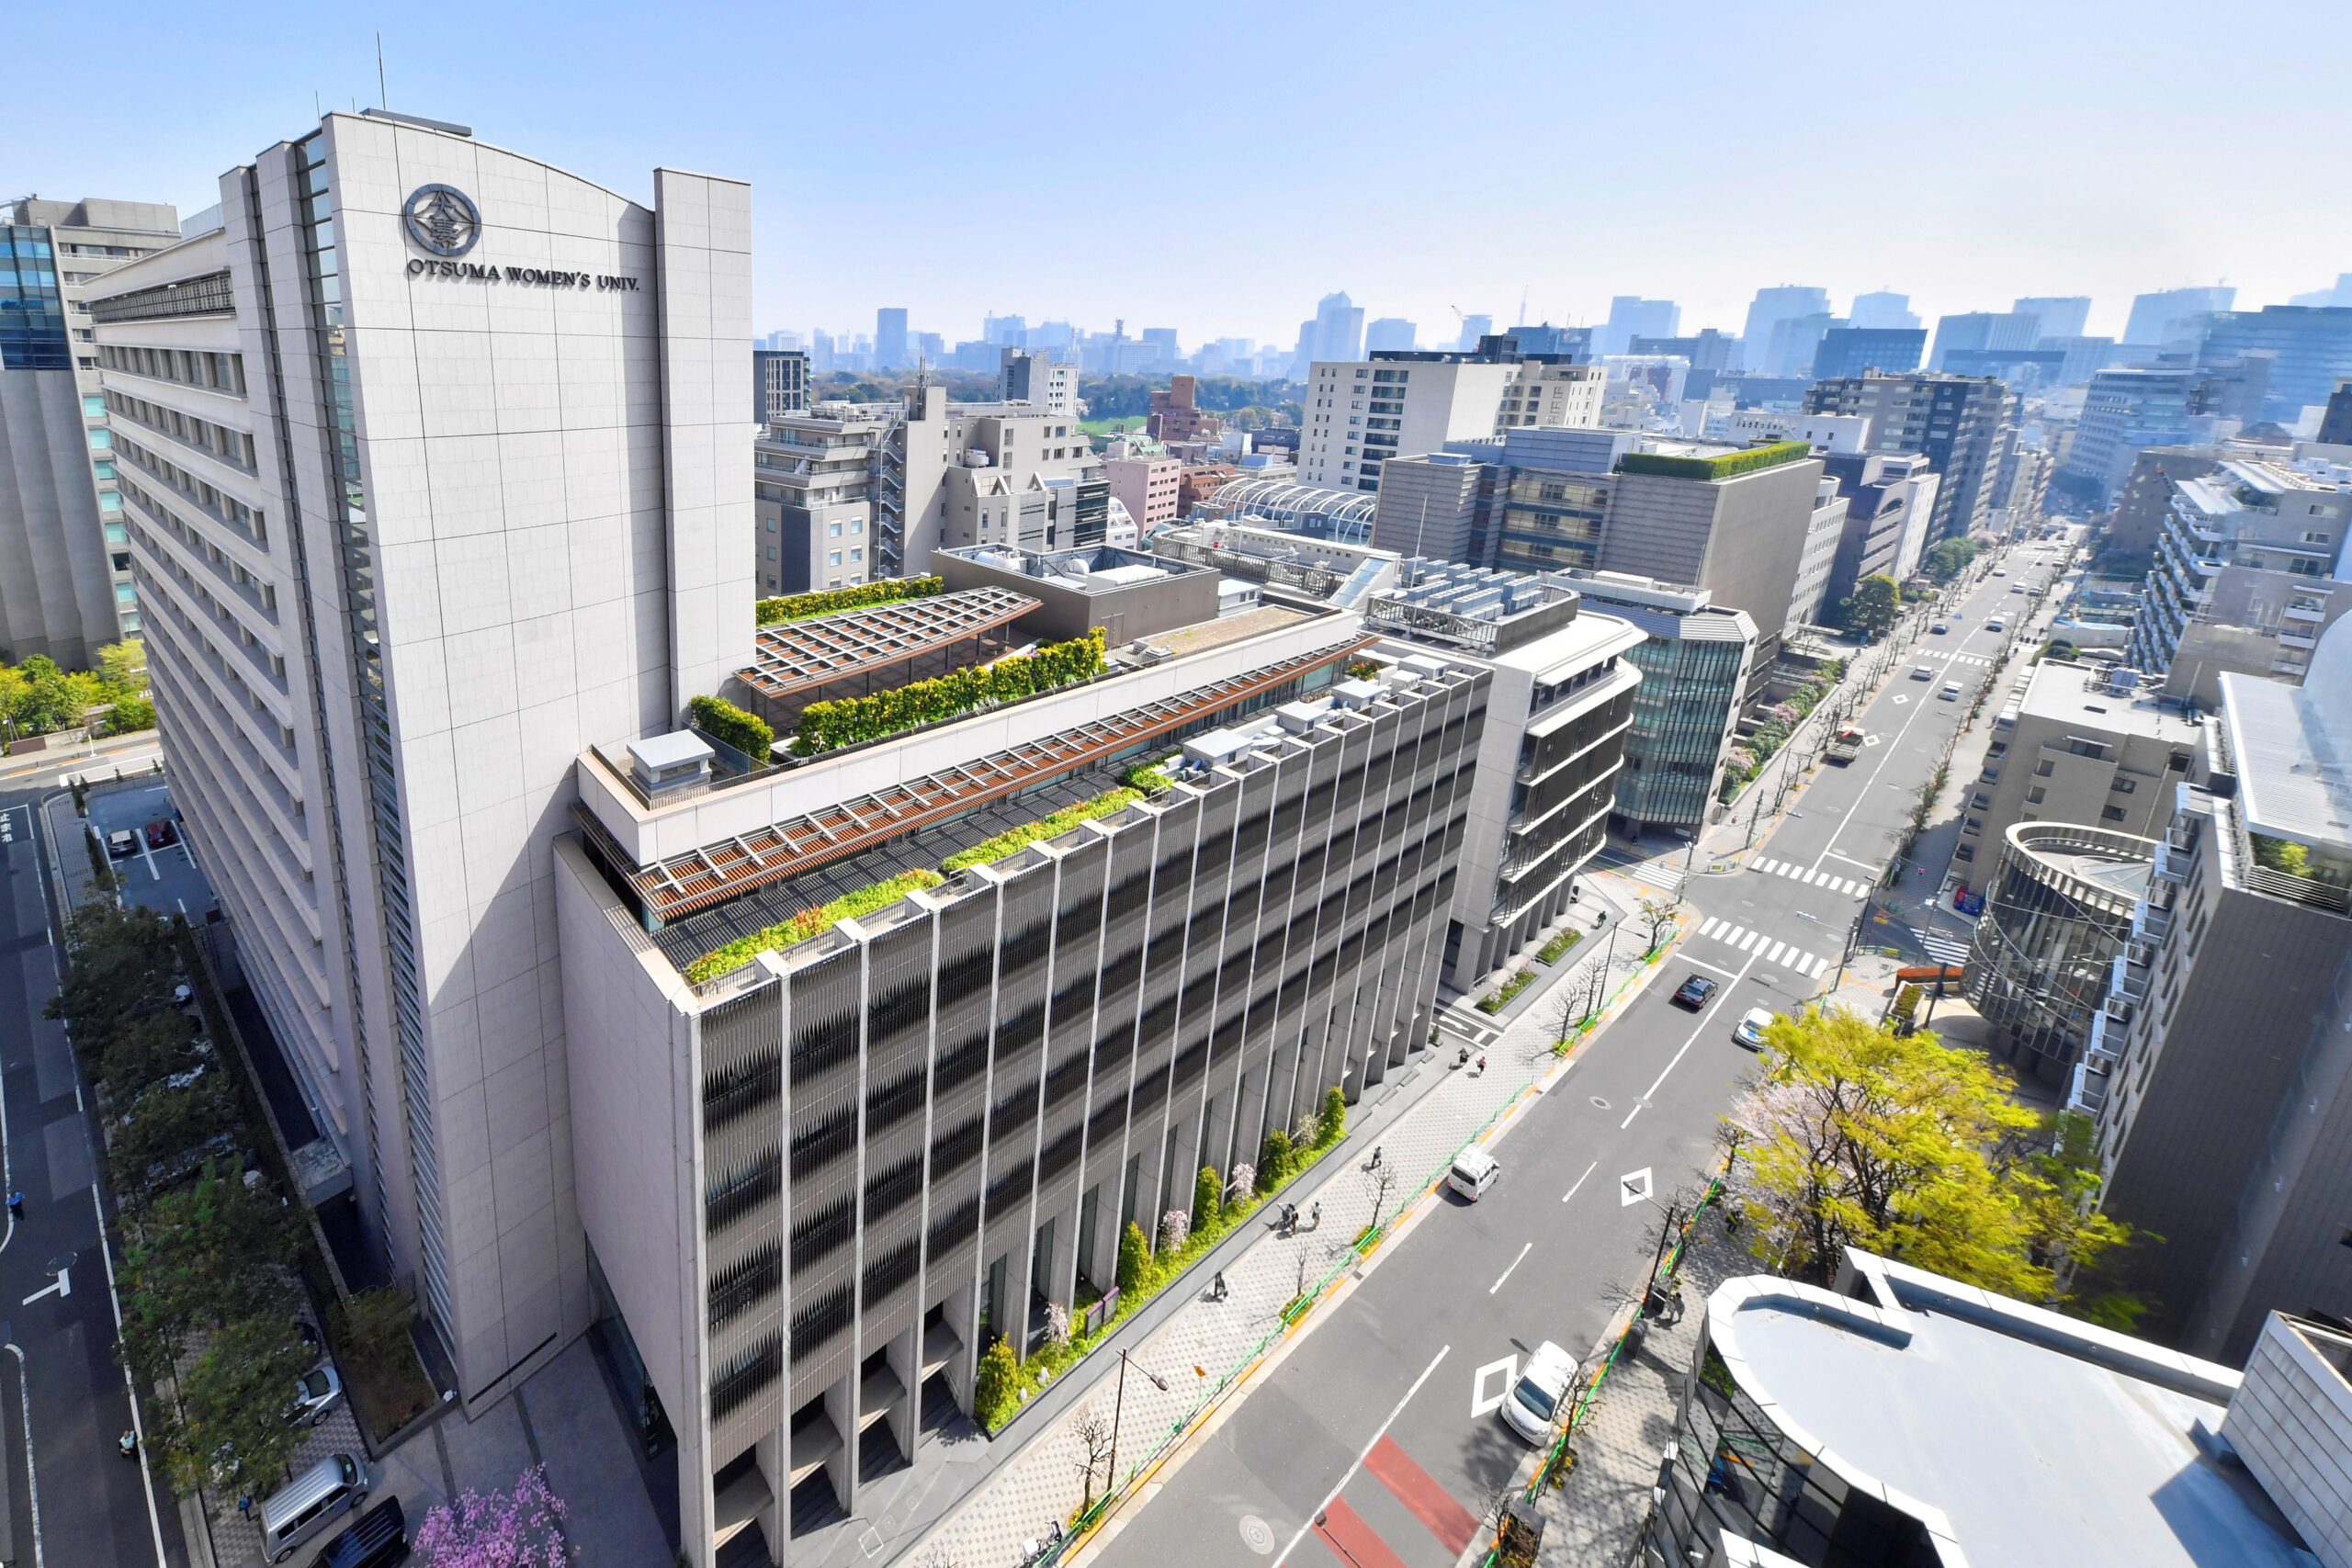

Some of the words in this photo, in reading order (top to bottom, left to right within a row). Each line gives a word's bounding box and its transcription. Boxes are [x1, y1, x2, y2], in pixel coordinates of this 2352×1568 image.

[408, 259, 502, 279] OTSUMA
[505, 266, 591, 287] WOMEN'S
[597, 275, 640, 291] UNIV.
